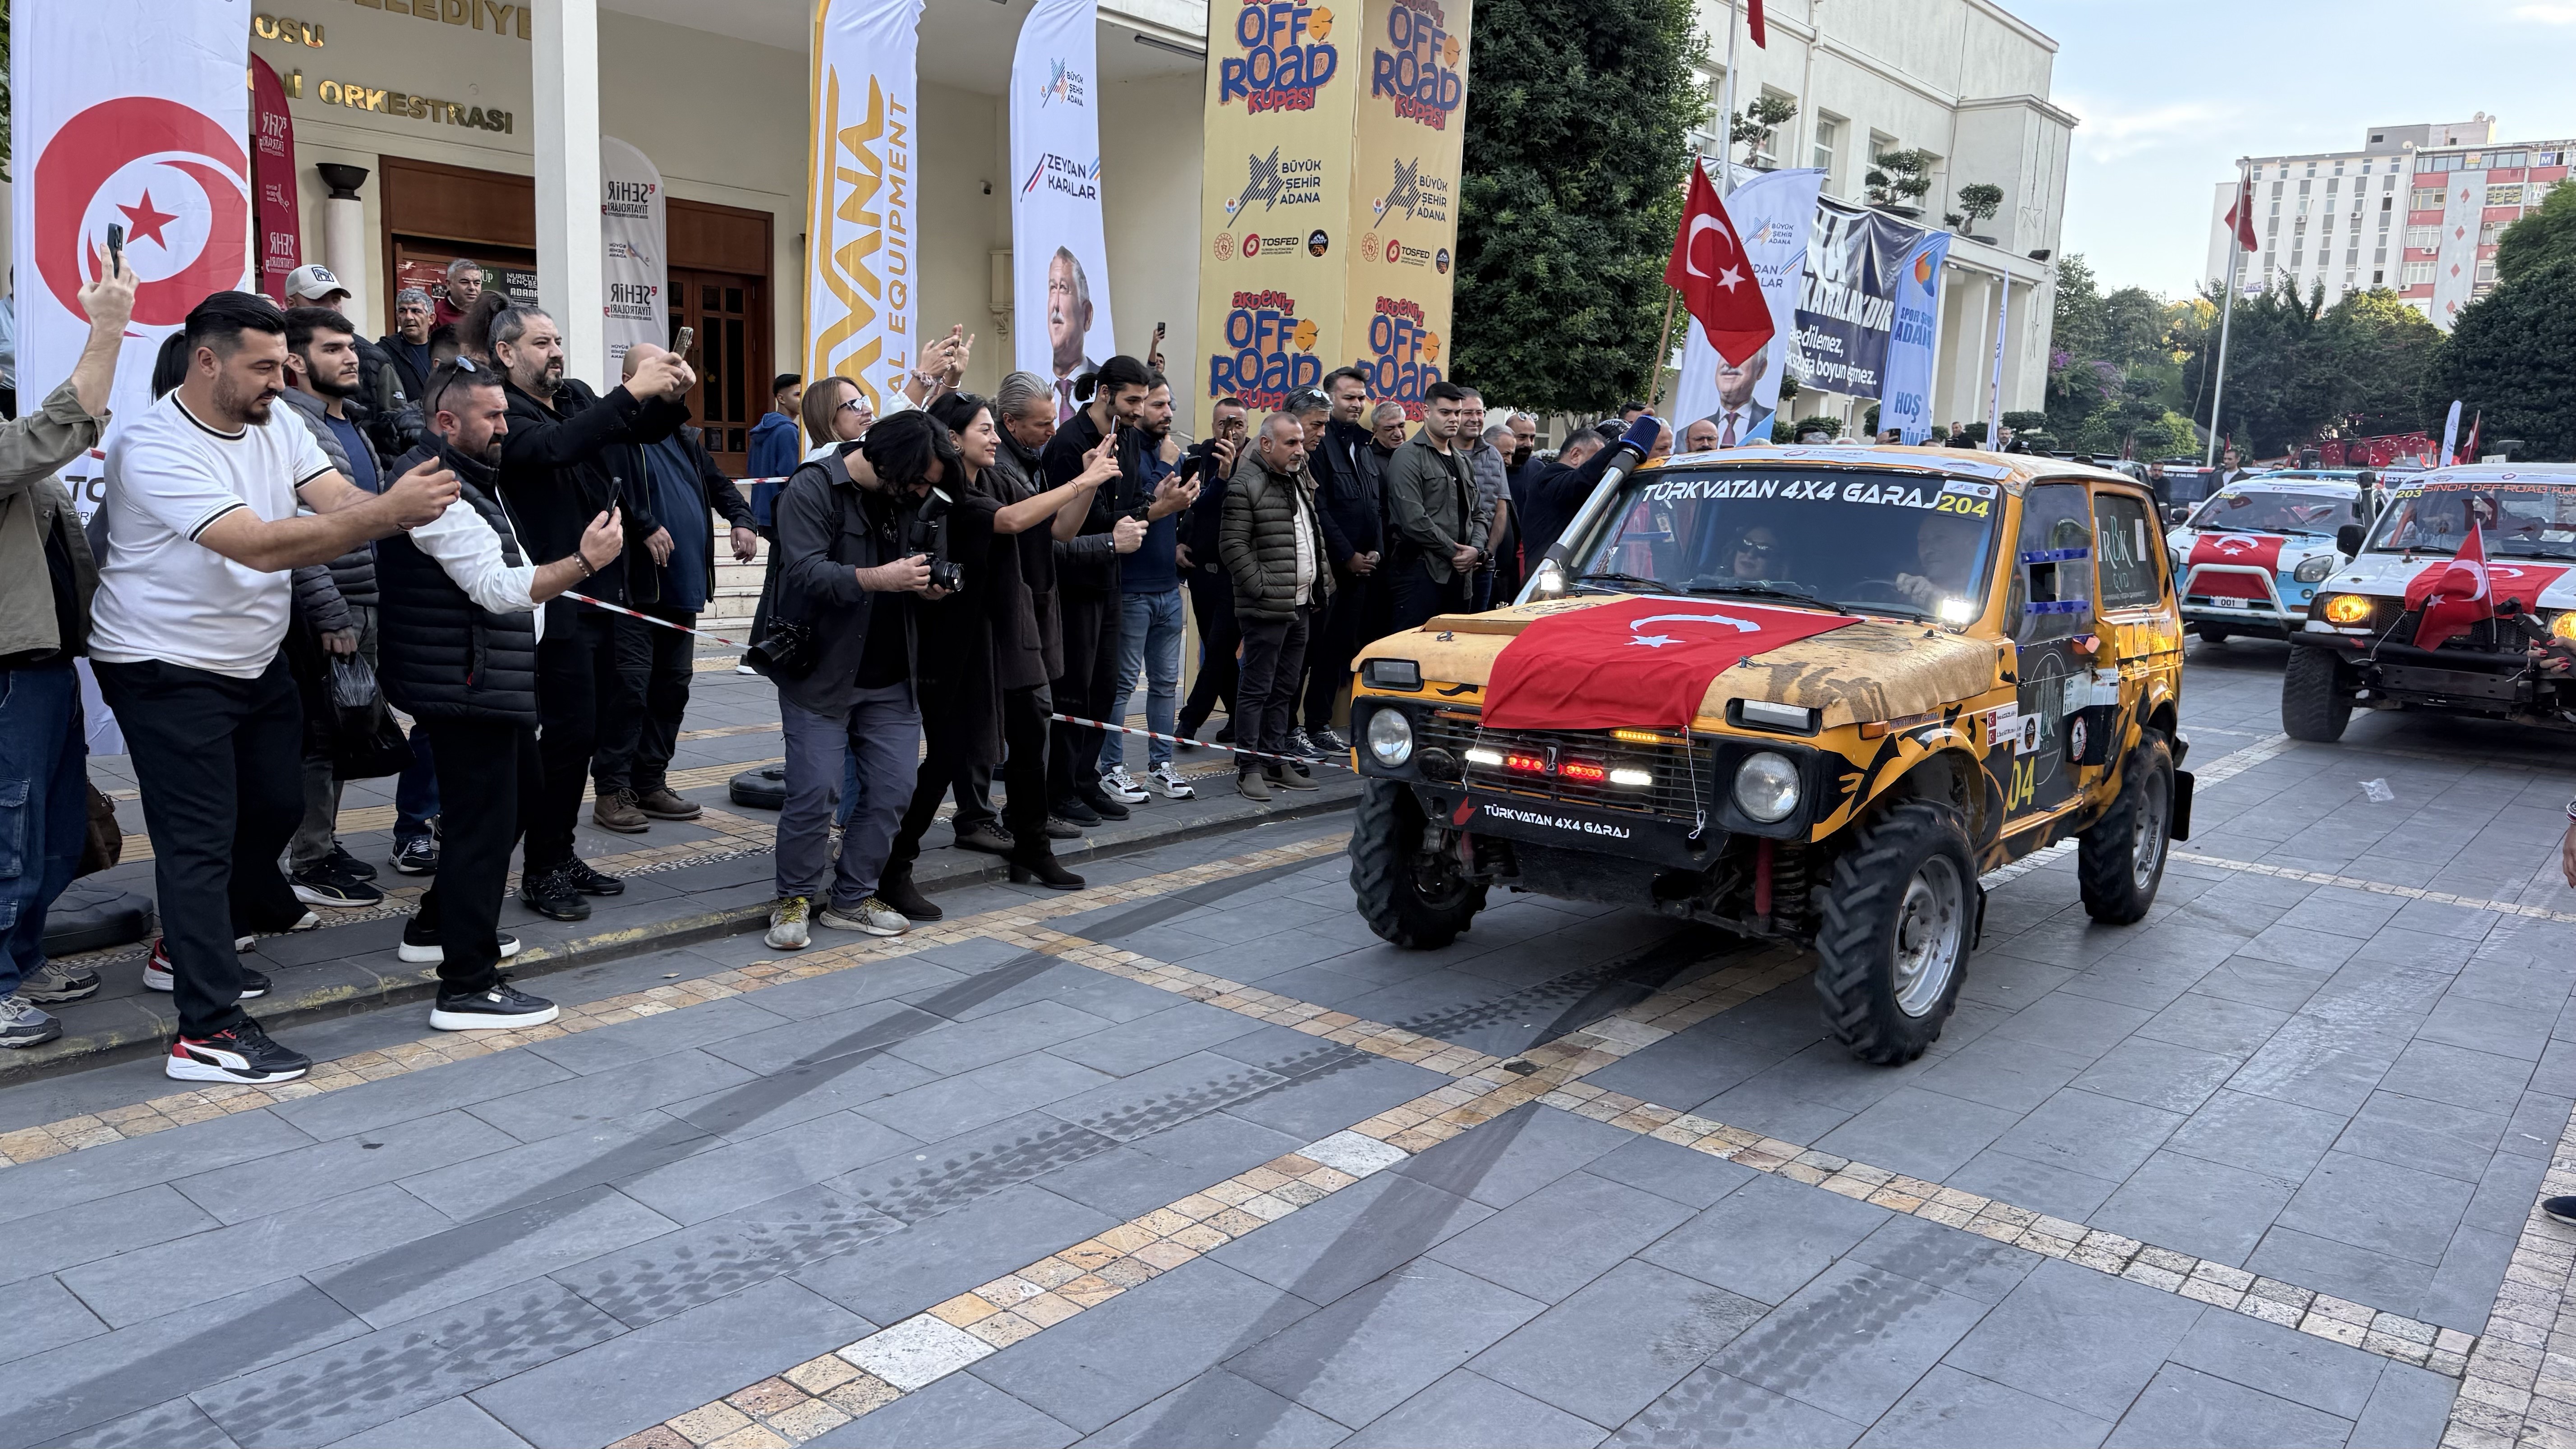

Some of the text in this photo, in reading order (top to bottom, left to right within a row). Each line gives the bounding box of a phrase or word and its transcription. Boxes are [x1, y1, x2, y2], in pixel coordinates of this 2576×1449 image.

[1238, 3, 1312, 48] OFF
[1389, 6, 1447, 62] OFF
[319, 80, 512, 134] ORKESTRASI
[1282, 160, 1321, 173] BÜYÜK
[1286, 174, 1320, 193] ŞEHİR
[1419, 175, 1448, 192] BÜYÜK
[1280, 193, 1320, 205] ADANA
[1421, 193, 1447, 208] ŞEHİR
[889, 93, 907, 334] EQUIPMENT
[1417, 208, 1446, 222] ADANA
[1261, 237, 1299, 246] TOSFED
[1402, 247, 1430, 259] TOSFED
[1227, 309, 1298, 352] OFF
[1370, 315, 1427, 362] OFF
[1816, 353, 1846, 383] boyun
[1894, 391, 1922, 423] HOŞ
[1642, 480, 1942, 509] TÜRKVATAN 4X4 GARAJ
[1937, 495, 1989, 518] 204
[2395, 489, 2422, 499] 203
[1484, 804, 1630, 839] TÜRKVATAN 4X4 GARAJ
